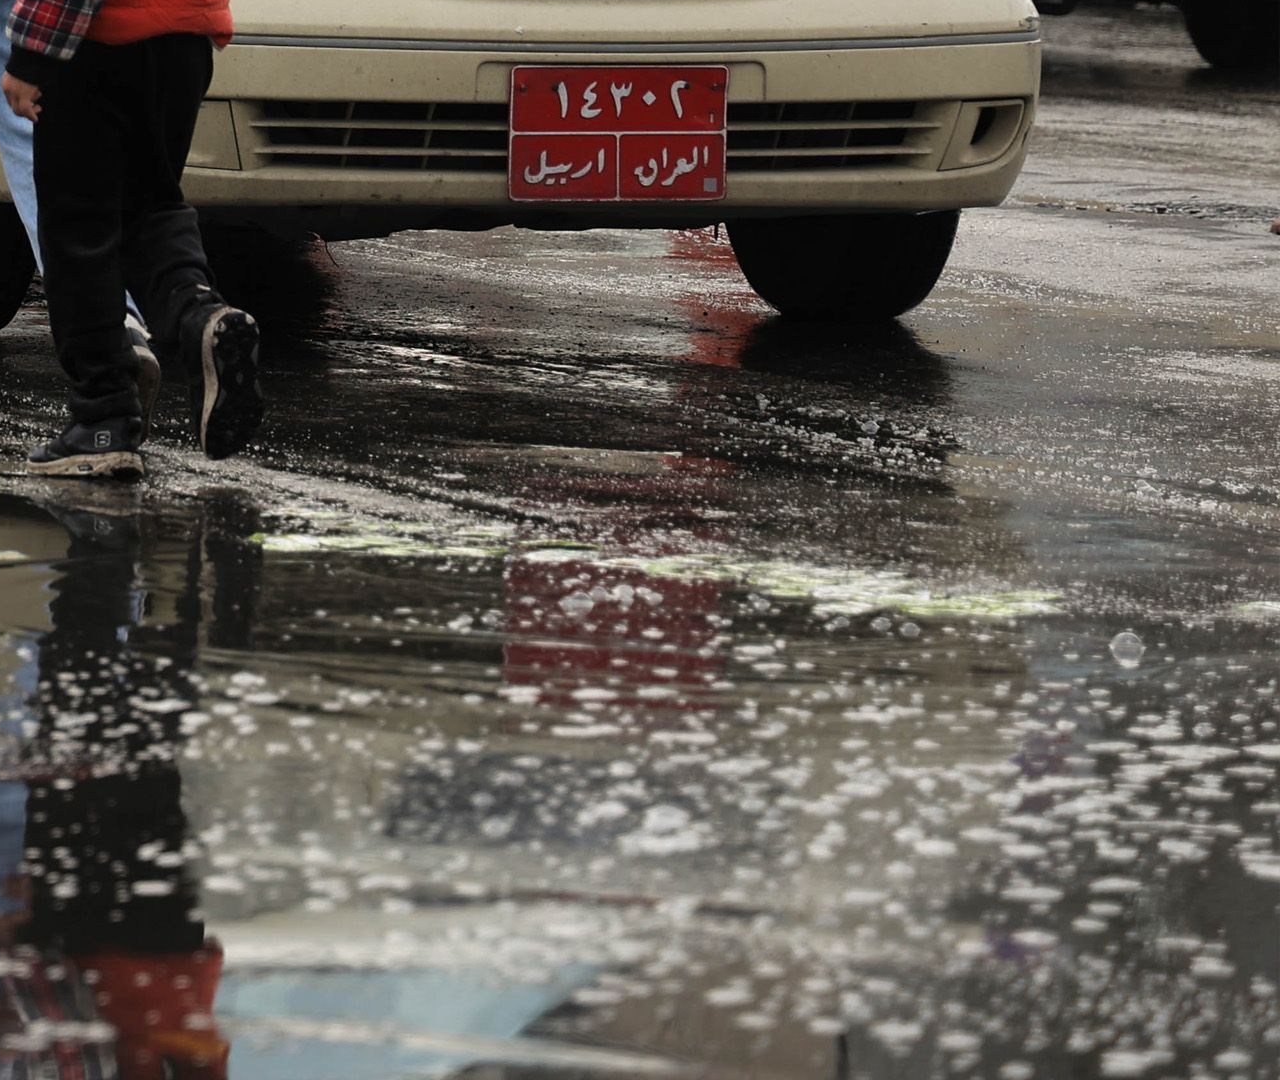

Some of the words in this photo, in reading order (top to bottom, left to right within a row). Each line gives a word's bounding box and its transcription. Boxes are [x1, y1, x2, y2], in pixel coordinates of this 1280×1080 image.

[557, 80, 688, 119] ١٤٣٠٢
[523, 148, 605, 185] اربيل
[634, 145, 709, 187] العراق
